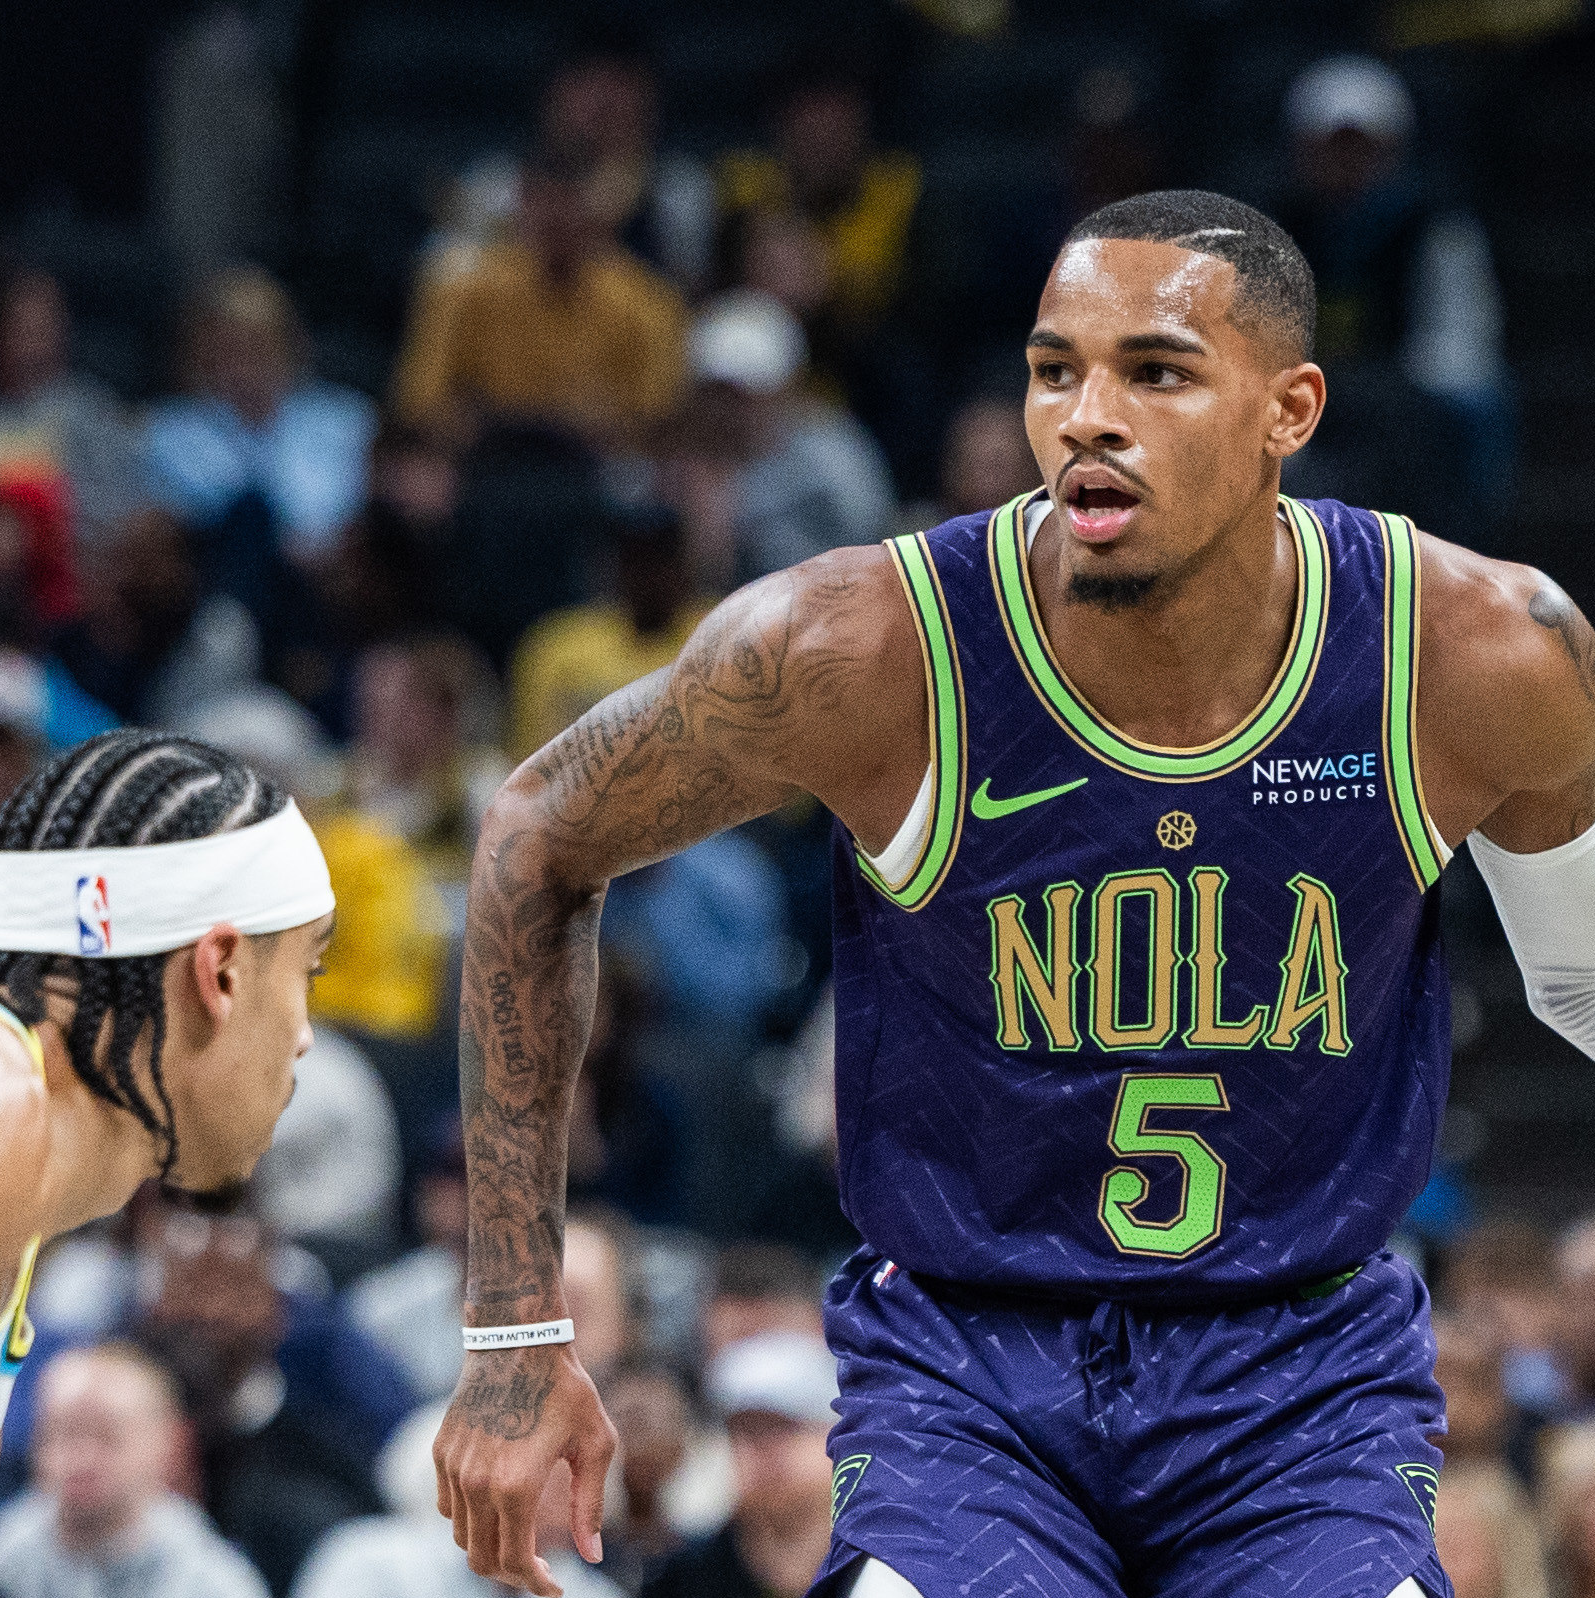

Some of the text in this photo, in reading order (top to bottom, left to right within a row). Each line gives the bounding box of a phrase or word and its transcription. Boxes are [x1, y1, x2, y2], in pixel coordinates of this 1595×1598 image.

[1252, 752, 1376, 784] NEWAGE
[1252, 783, 1376, 806] PRODUCTS
[986, 865, 1354, 1057] NOLA
[1098, 1072, 1231, 1259] 5
